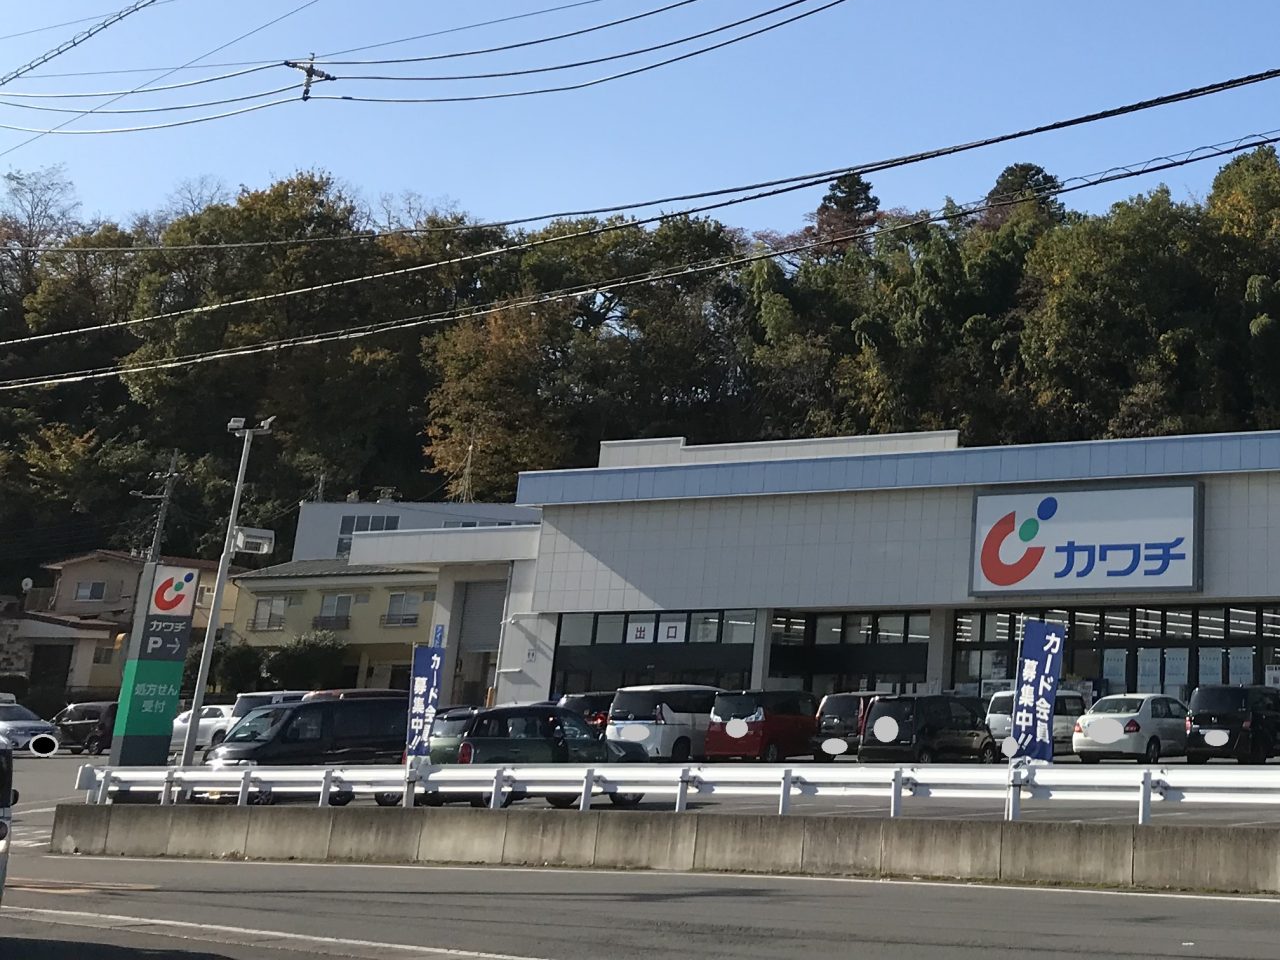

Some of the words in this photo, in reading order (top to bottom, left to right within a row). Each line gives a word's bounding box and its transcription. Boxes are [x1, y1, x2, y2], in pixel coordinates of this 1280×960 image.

[1054, 537, 1186, 579] カワチ
[149, 621, 187, 632] カワチ
[635, 626, 677, 639] 出口
[147, 637, 162, 653] P
[134, 683, 179, 696] 処方せん
[1036, 632, 1061, 744] カード会員
[141, 700, 166, 713] 受付
[421, 653, 441, 747] カード会員
